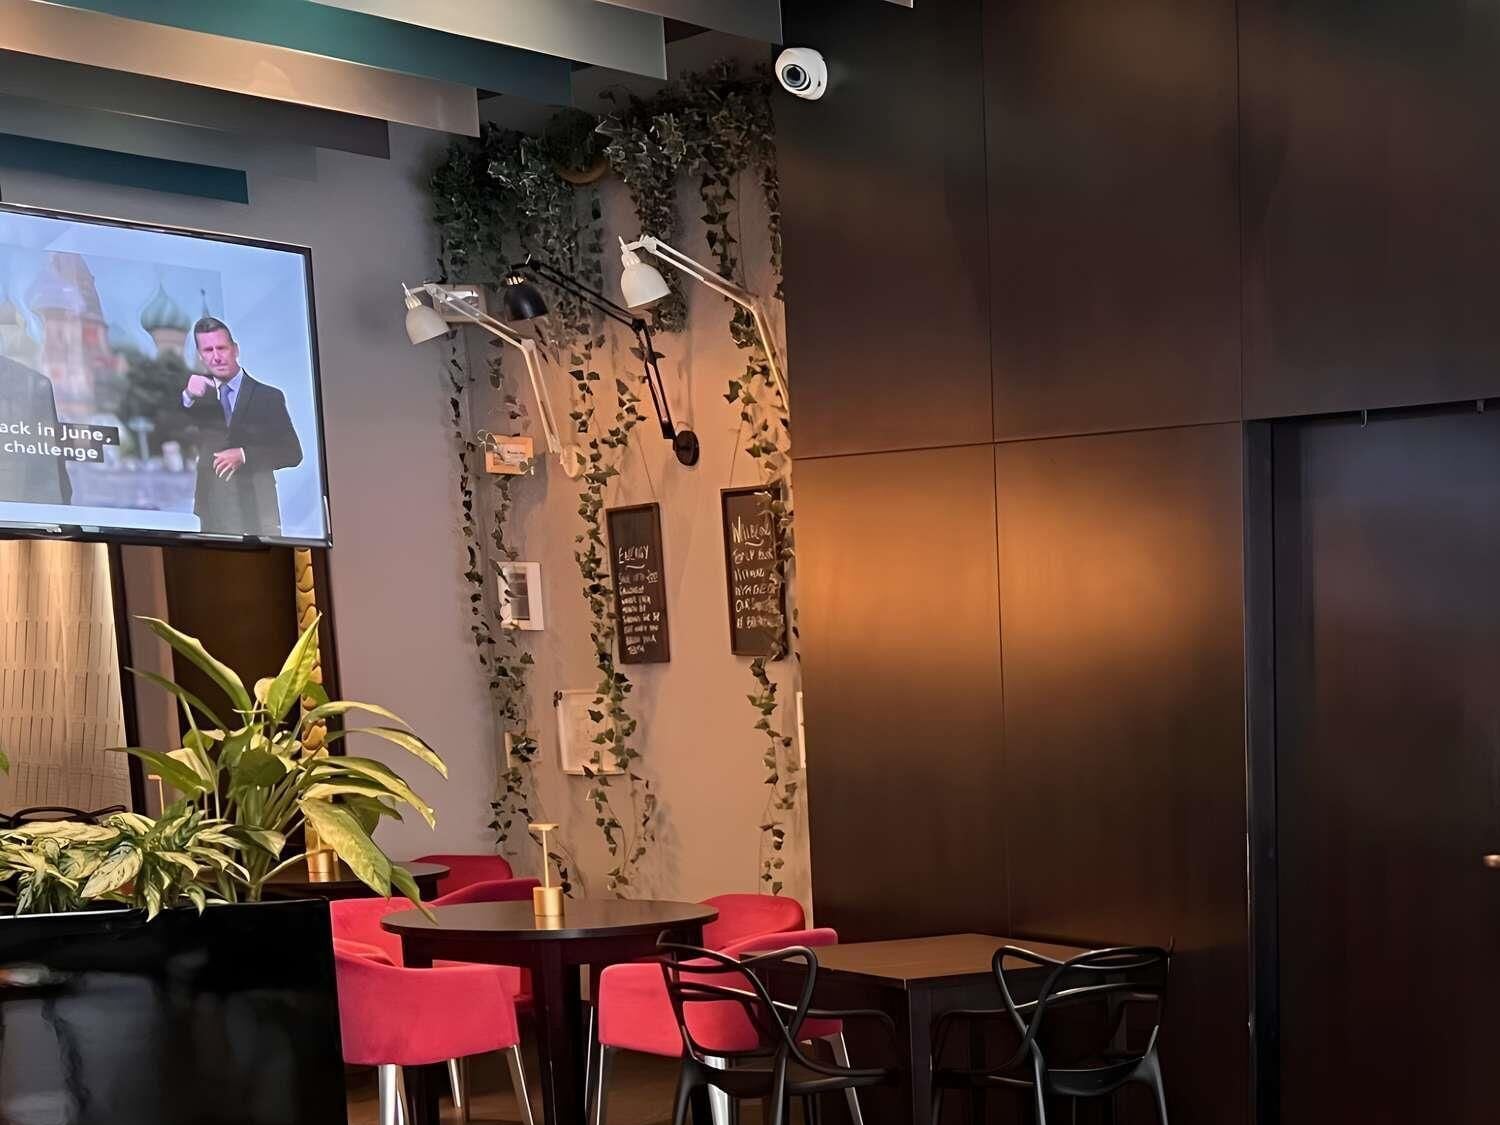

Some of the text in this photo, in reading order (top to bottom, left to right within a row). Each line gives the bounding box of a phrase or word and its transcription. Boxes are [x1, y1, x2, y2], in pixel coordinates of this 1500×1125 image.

[38, 422, 55, 437] in
[60, 425, 112, 444] June,
[4, 440, 98, 461] challenge
